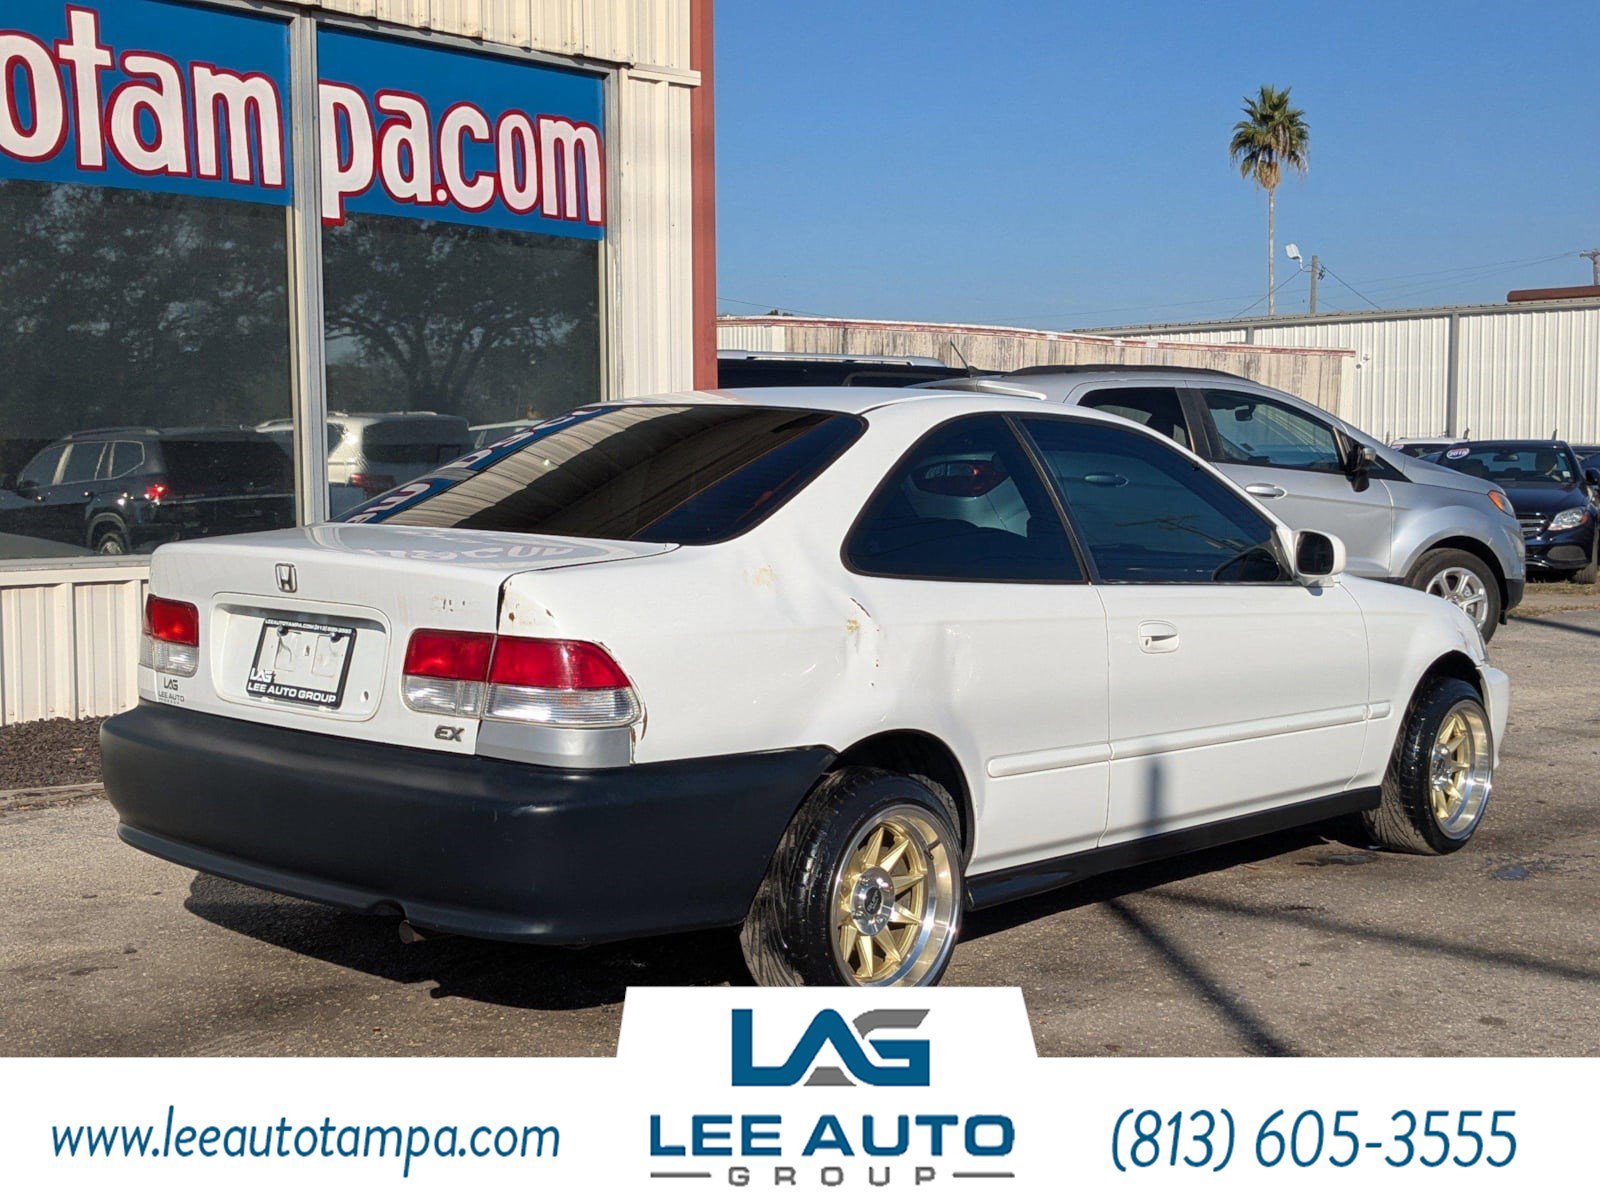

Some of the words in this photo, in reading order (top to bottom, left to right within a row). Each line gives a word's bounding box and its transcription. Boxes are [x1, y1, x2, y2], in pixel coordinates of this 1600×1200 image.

[248, 682, 266, 692] LEE
[267, 685, 297, 697] AUTO
[298, 690, 336, 703] GROUP
[434, 725, 465, 742] EX
